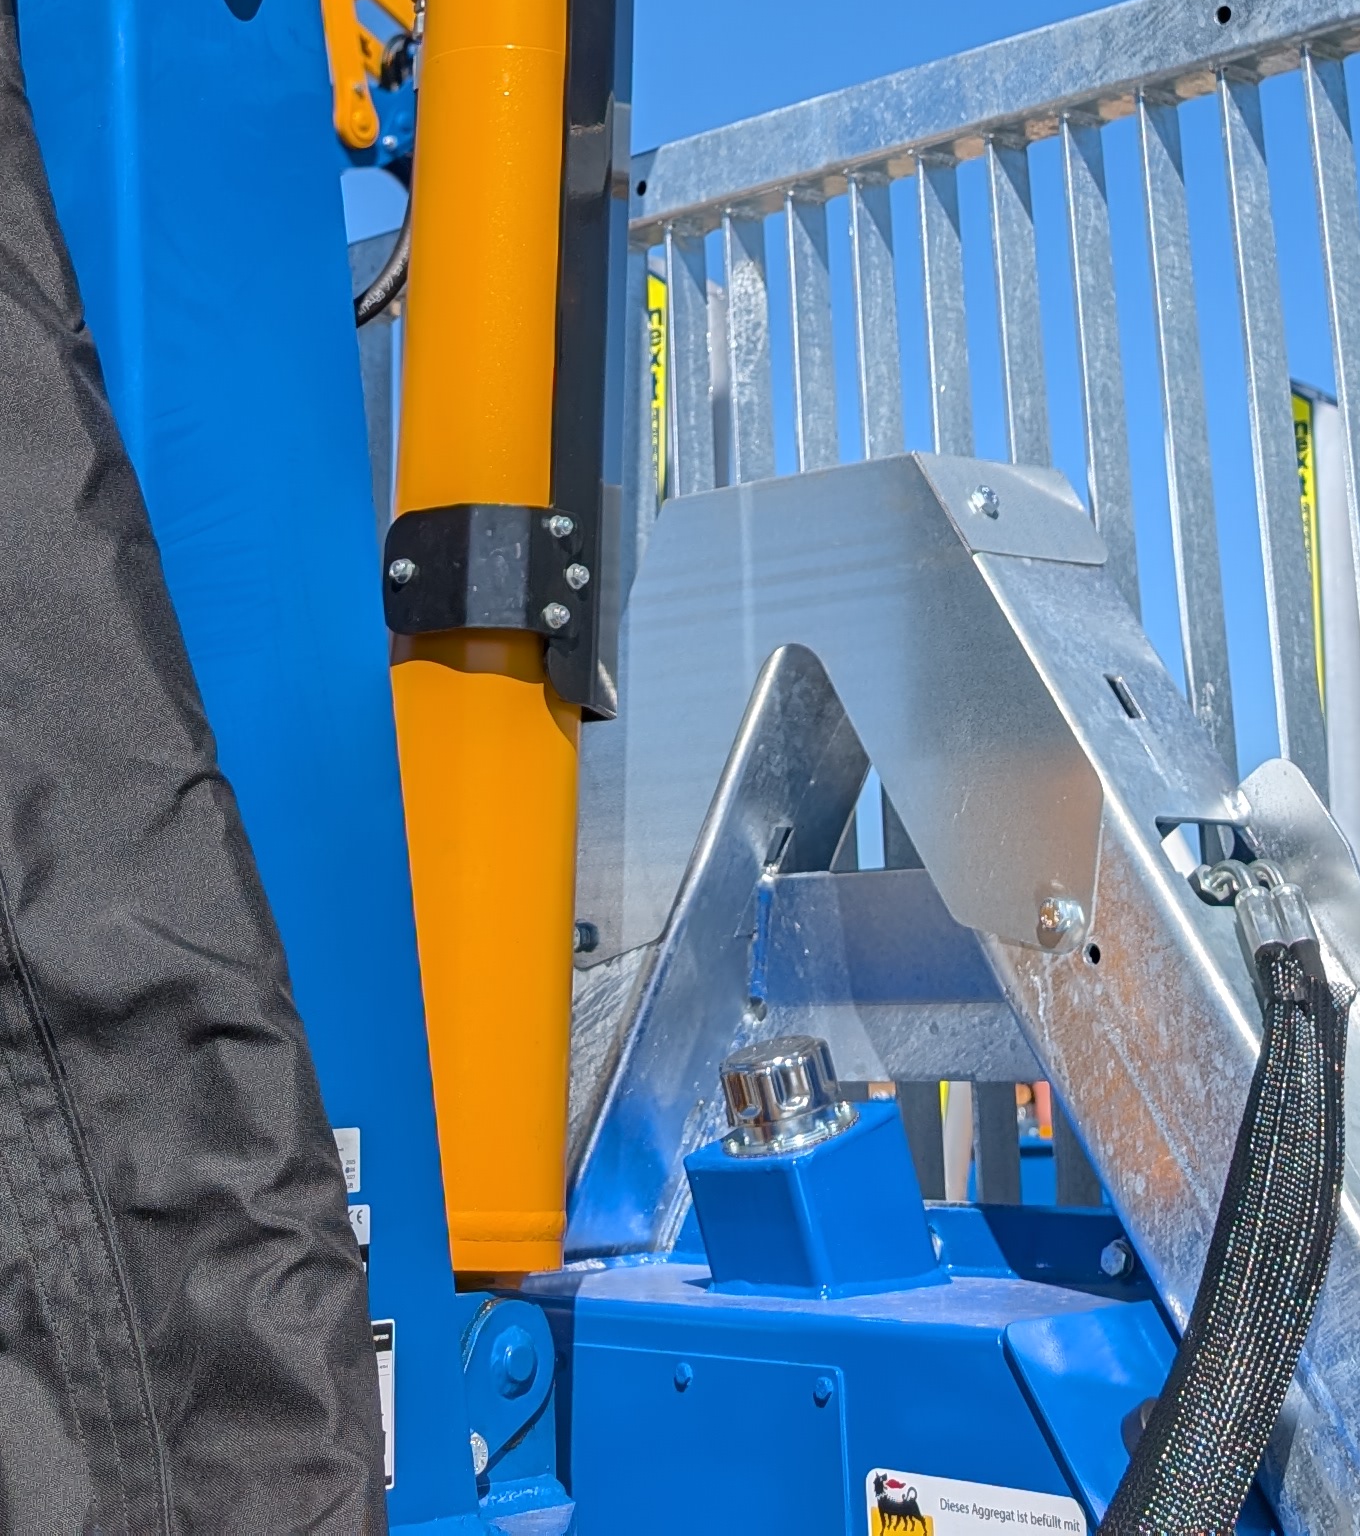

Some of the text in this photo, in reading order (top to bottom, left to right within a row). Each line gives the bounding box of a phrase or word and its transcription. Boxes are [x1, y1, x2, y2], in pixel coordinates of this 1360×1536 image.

[940, 1497, 1080, 1532] Dieses Aggregat ist befüllt mit
